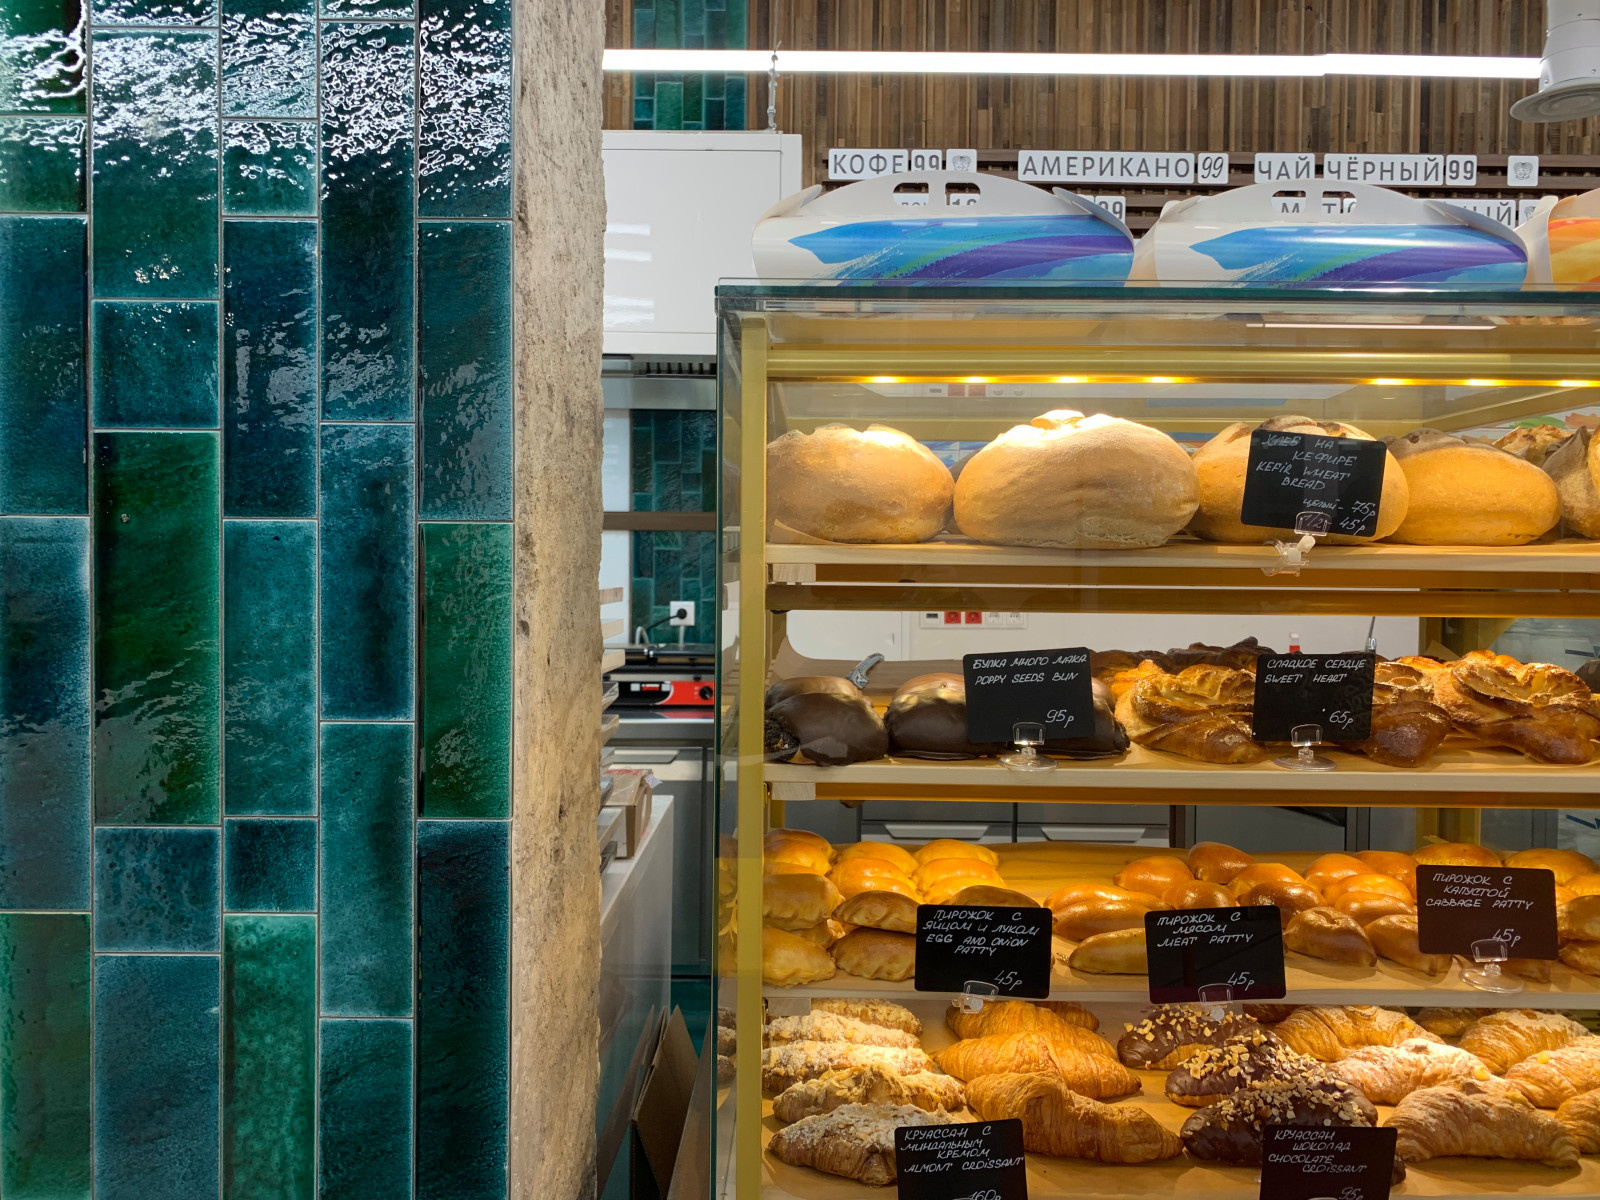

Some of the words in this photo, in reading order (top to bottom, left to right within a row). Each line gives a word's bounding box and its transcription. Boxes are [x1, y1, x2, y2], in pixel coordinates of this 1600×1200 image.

[833, 153, 904, 174] КОФЕ
[914, 154, 940, 170] 99
[1022, 155, 1190, 178] АМЕРИКАНО
[1201, 156, 1224, 179] 99
[1258, 156, 1310, 180] ЧАЙ
[1327, 156, 1439, 182] ЧЁРНЫЙ
[1449, 159, 1475, 180] 99
[1315, 439, 1334, 450] НА
[1292, 451, 1357, 466] КЕФИРЕ
[1303, 467, 1351, 480] WHEAT
[1281, 477, 1326, 490] BREAD
[972, 659, 1007, 670] БУЛКА
[1010, 656, 1050, 667] МНОГО
[1052, 654, 1087, 664] МАКА
[1267, 659, 1318, 669] СЛАДКОЕ
[1325, 659, 1366, 671] СЕРДЦЕ
[975, 675, 1007, 685] POPPY
[1012, 672, 1045, 684] SEEDS
[1264, 673, 1303, 684] SWEET
[1313, 673, 1347, 684] HEART
[1432, 873, 1491, 885] ПИРОЖОК
[1443, 885, 1511, 898] КАПУСТОЙ
[1425, 898, 1482, 908] CABBAGE
[1492, 900, 1534, 910] PATTY
[933, 909, 994, 921] ПИРОЖОК
[1157, 913, 1216, 926] ПИРОЖОК
[922, 918, 973, 932] ЯЙЦОМ
[992, 924, 1040, 936] ЛУКОМ
[1173, 924, 1227, 935] МЯСОМ
[925, 934, 954, 944] EGG
[963, 936, 986, 946] AND
[1157, 936, 1198, 948] MEAT
[1209, 933, 1254, 944] PATTY
[954, 945, 997, 956] PATTY
[904, 1128, 969, 1141] КРУАССАН
[1274, 1129, 1336, 1141] КРУАССАН
[900, 1139, 983, 1152] МИНДАЛЬНЫМ
[1292, 1141, 1351, 1152] ШОКОЛАД
[937, 1148, 990, 1159] КРЕМОМ
[1268, 1153, 1335, 1164] CHOCOLATE
[904, 1162, 953, 1173] ALMONT
